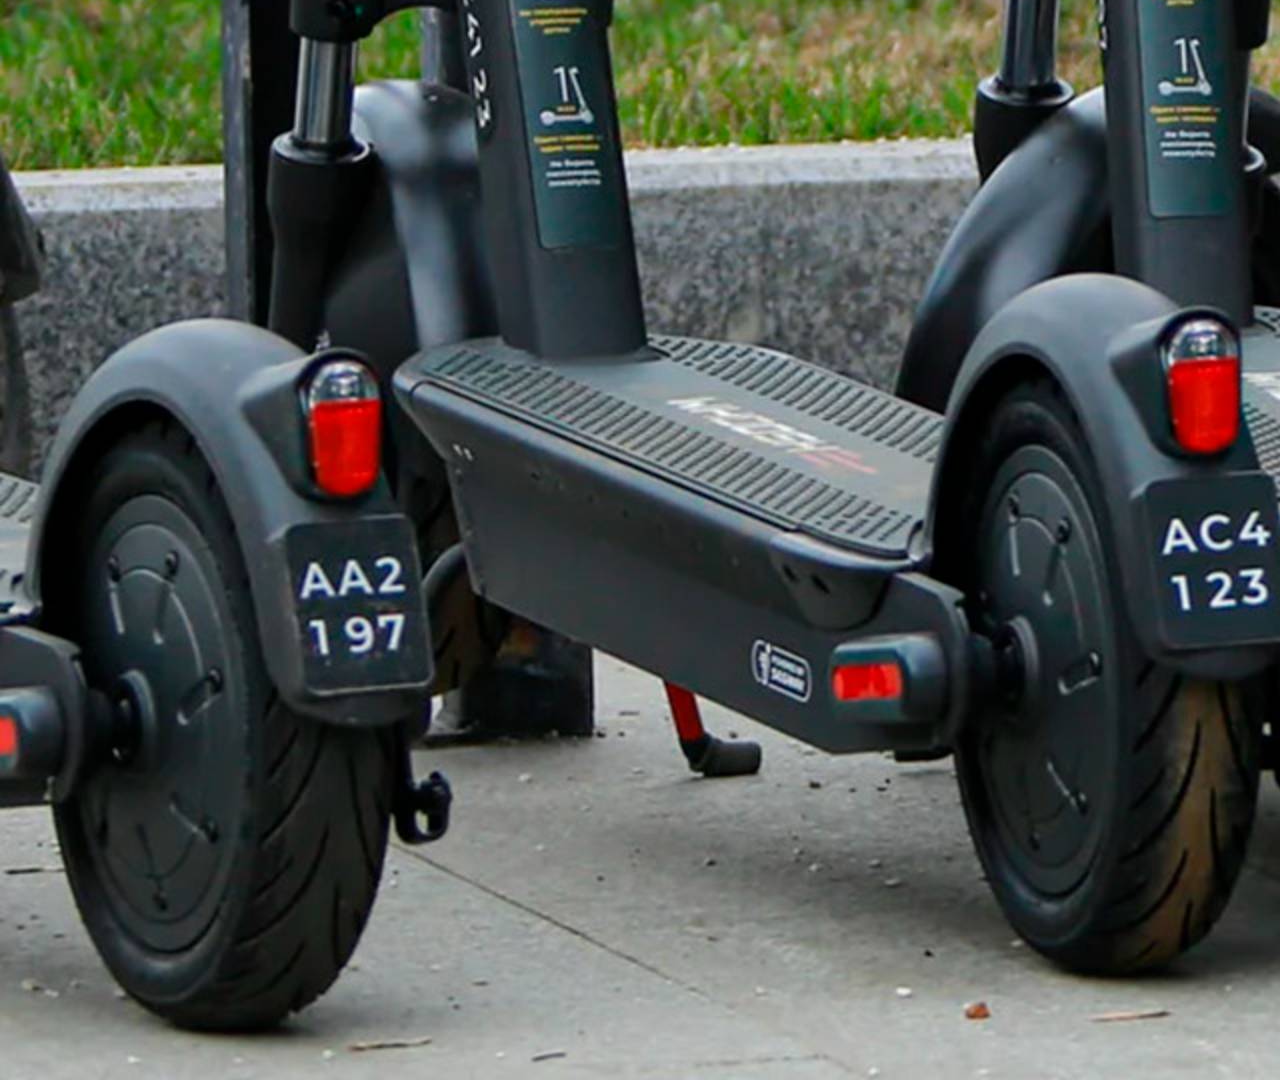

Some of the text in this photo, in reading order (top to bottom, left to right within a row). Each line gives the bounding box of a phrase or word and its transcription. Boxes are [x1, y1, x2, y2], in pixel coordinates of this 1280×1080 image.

[1162, 511, 1272, 556] AC4
[300, 556, 407, 599] AA2
[1171, 568, 1269, 611] 123
[309, 613, 405, 656] 197
